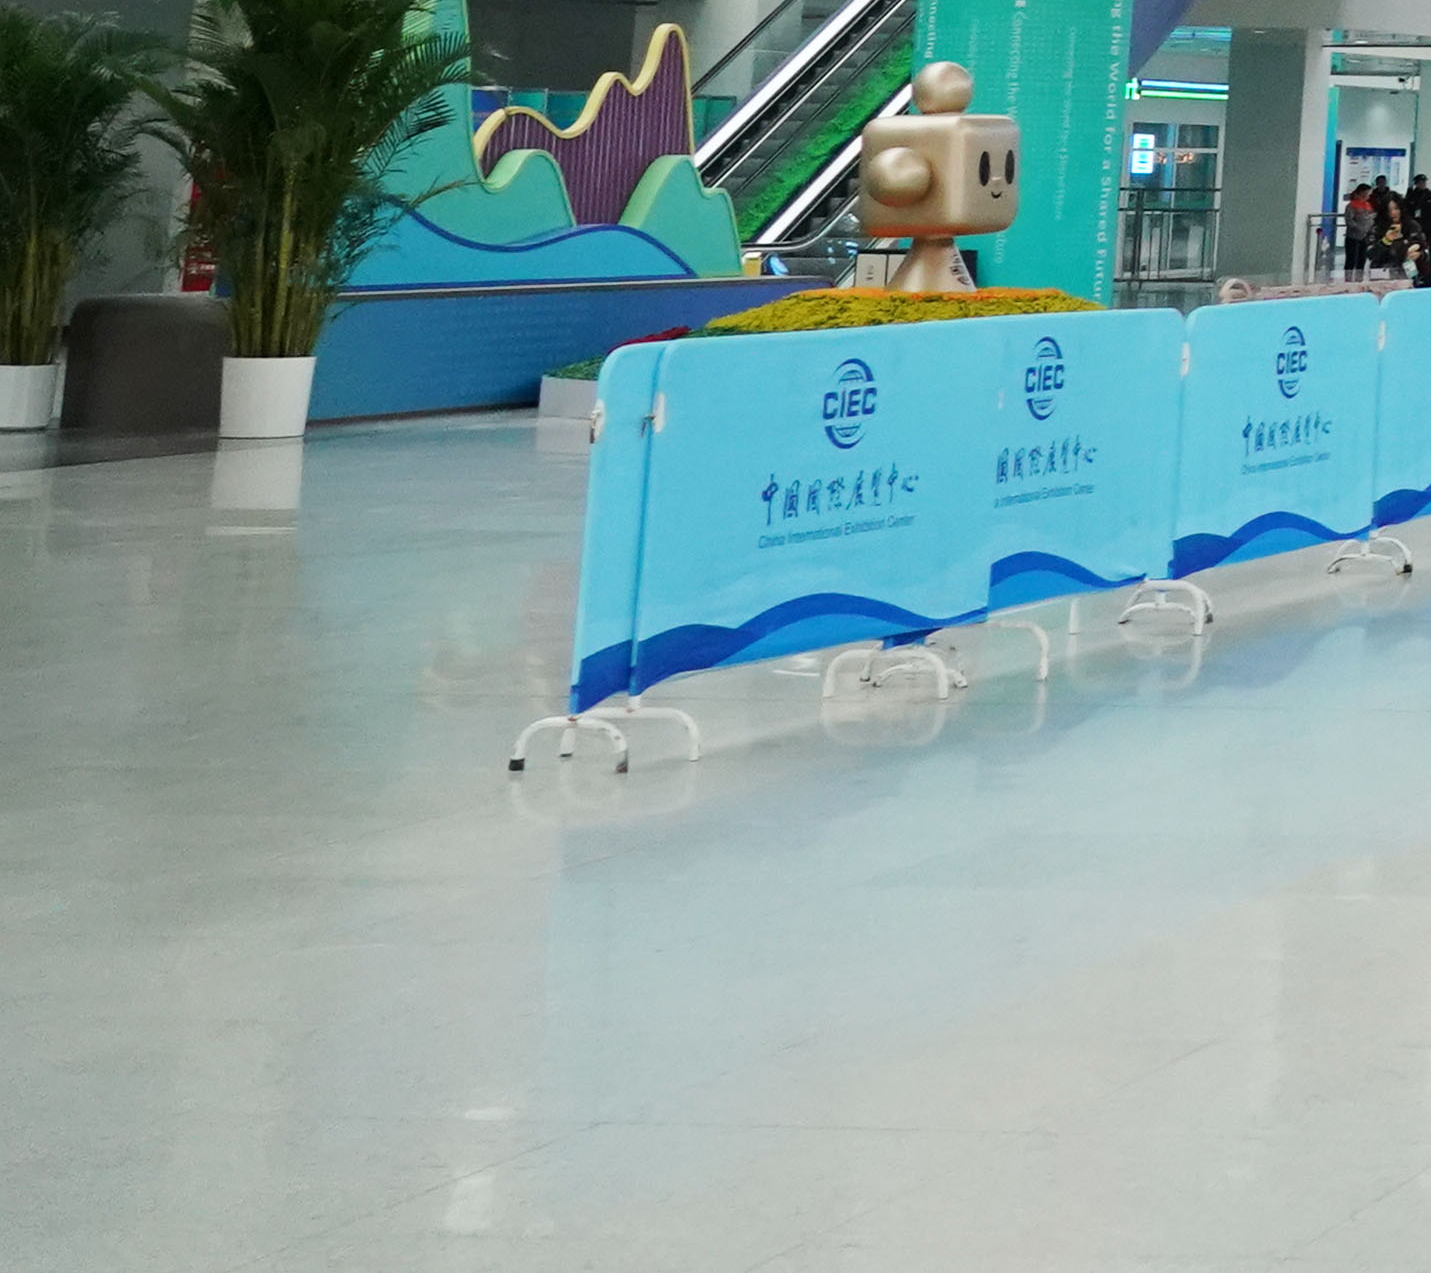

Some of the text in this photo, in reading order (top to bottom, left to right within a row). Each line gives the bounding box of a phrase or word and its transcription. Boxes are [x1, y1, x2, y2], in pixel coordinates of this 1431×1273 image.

[1277, 351, 1308, 375] CIEC
[1025, 365, 1065, 393] CIEC
[822, 387, 877, 421] CIEC
